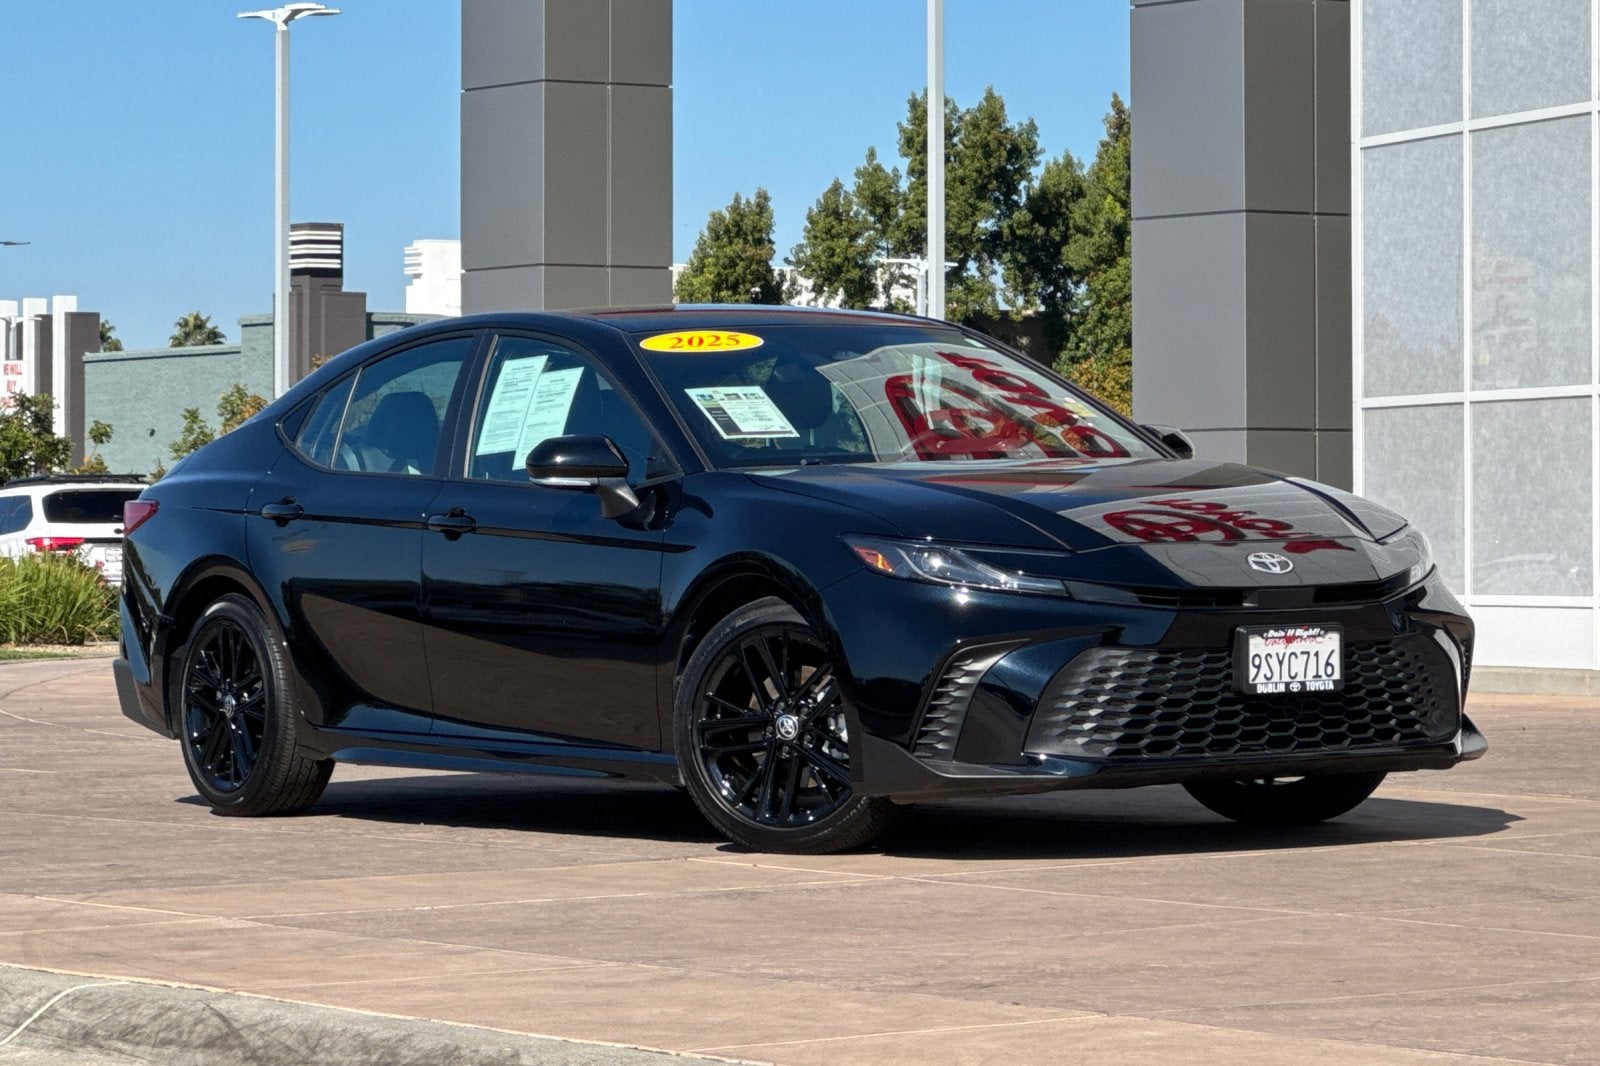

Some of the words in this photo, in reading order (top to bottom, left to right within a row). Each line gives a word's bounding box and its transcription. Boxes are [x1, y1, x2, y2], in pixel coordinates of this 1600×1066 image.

[670, 334, 741, 349] 2025
[1251, 649, 1335, 682] 9SYC716
[1257, 682, 1285, 693] DUBLIN
[1307, 680, 1334, 691] TOYOTA
